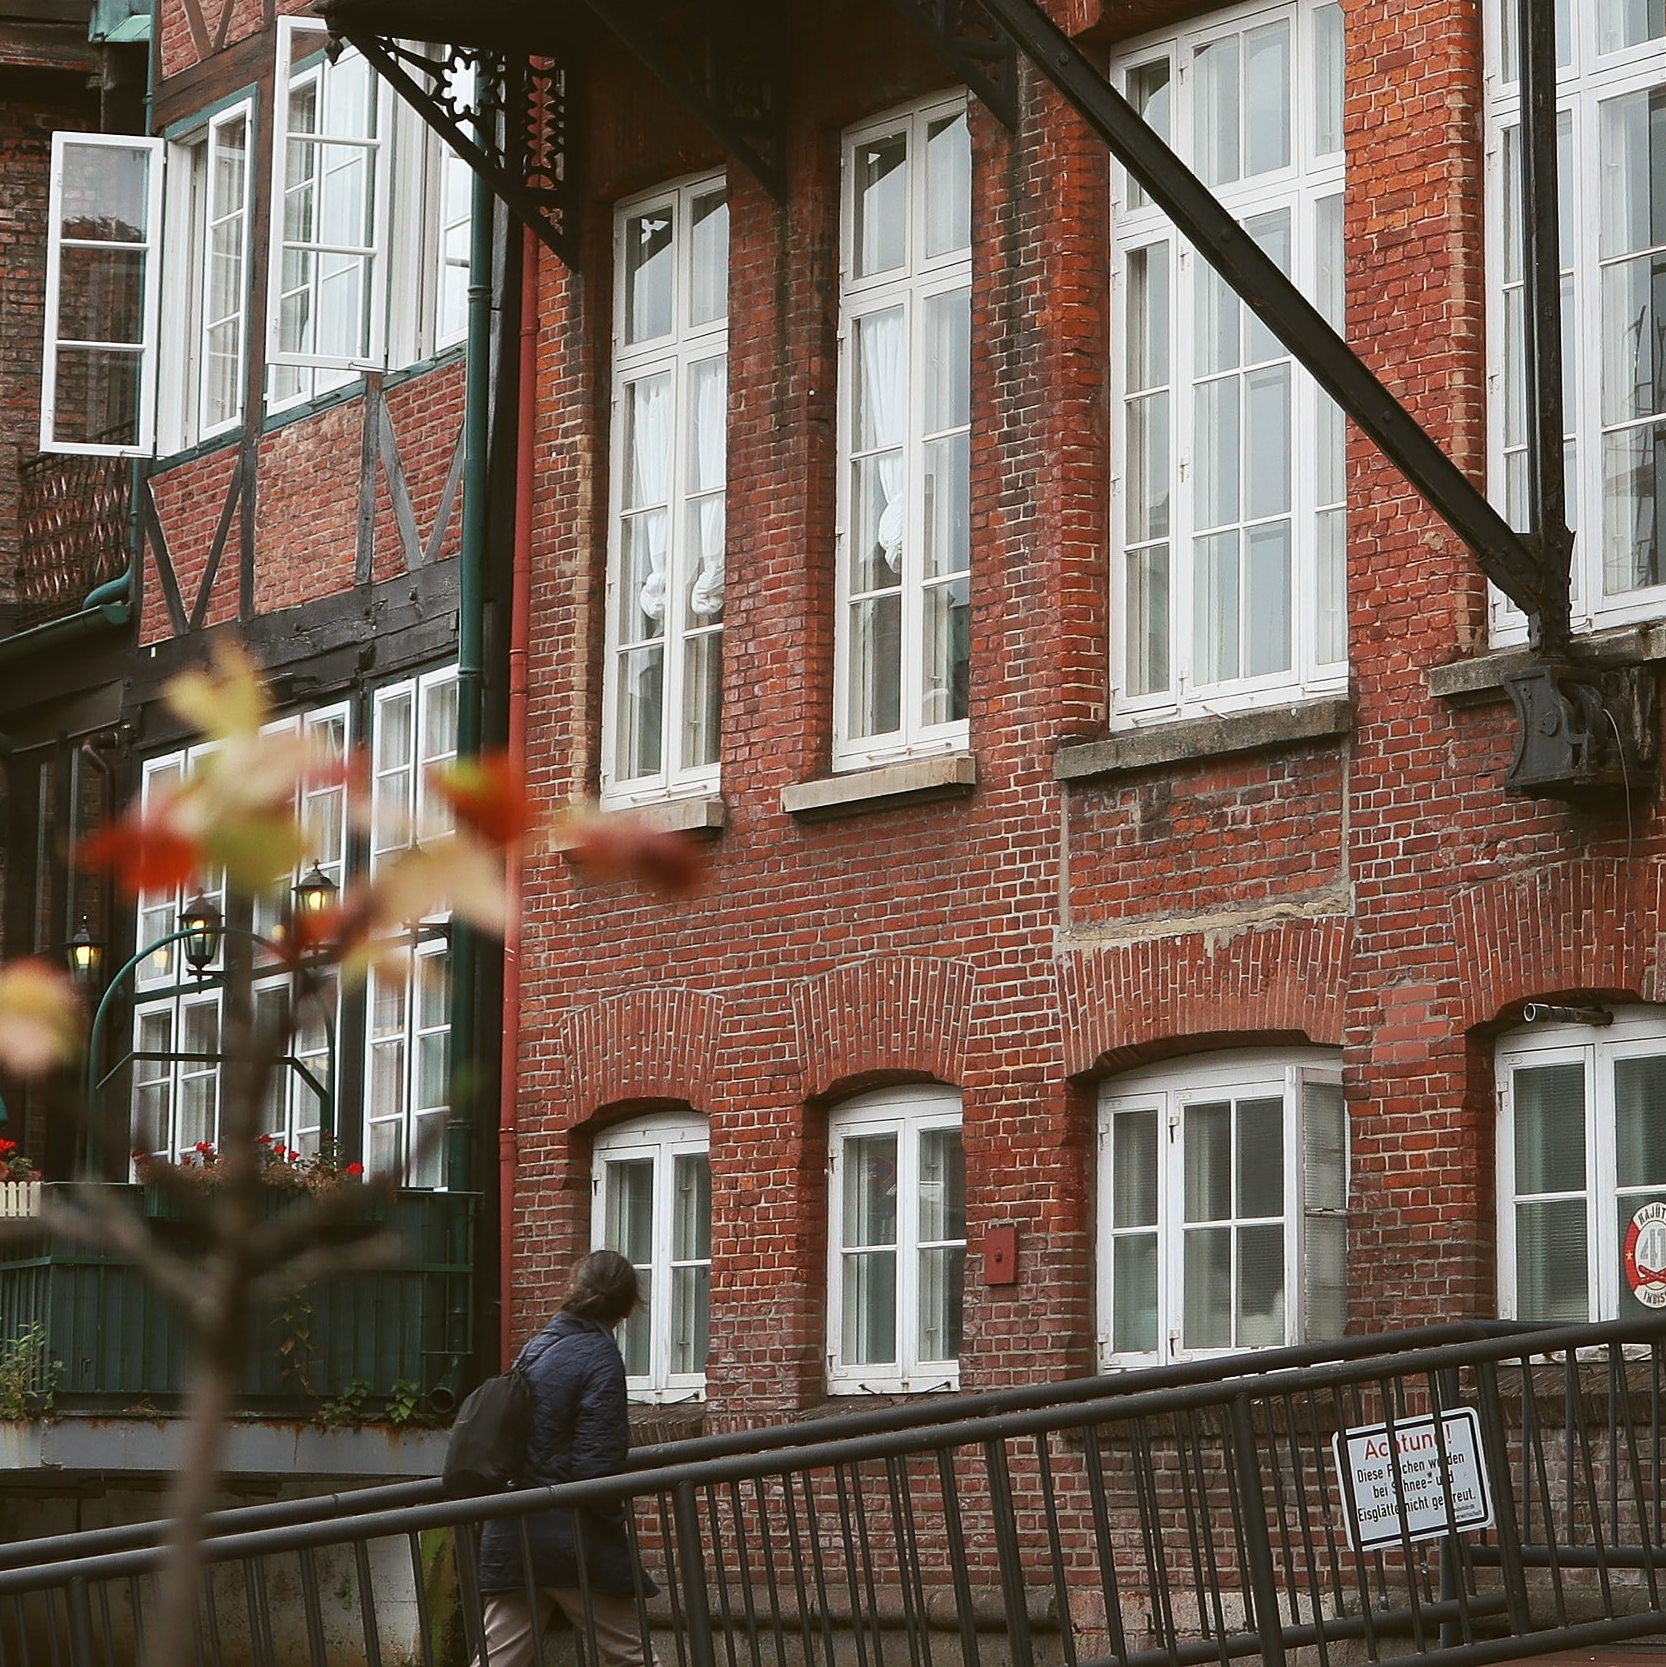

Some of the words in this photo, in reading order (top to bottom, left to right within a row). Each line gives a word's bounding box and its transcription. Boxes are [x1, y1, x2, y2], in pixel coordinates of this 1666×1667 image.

[1639, 1228, 1666, 1268] 41
[1364, 1423, 1452, 1461] Actun!
[1357, 1467, 1383, 1483] Diese
[1387, 1460, 1425, 1477] Fchen
[1372, 1483, 1388, 1499] bei
[1392, 1479, 1432, 1495] Shnee-
[1436, 1470, 1454, 1486] ud
[1432, 1487, 1476, 1511] gereut.
